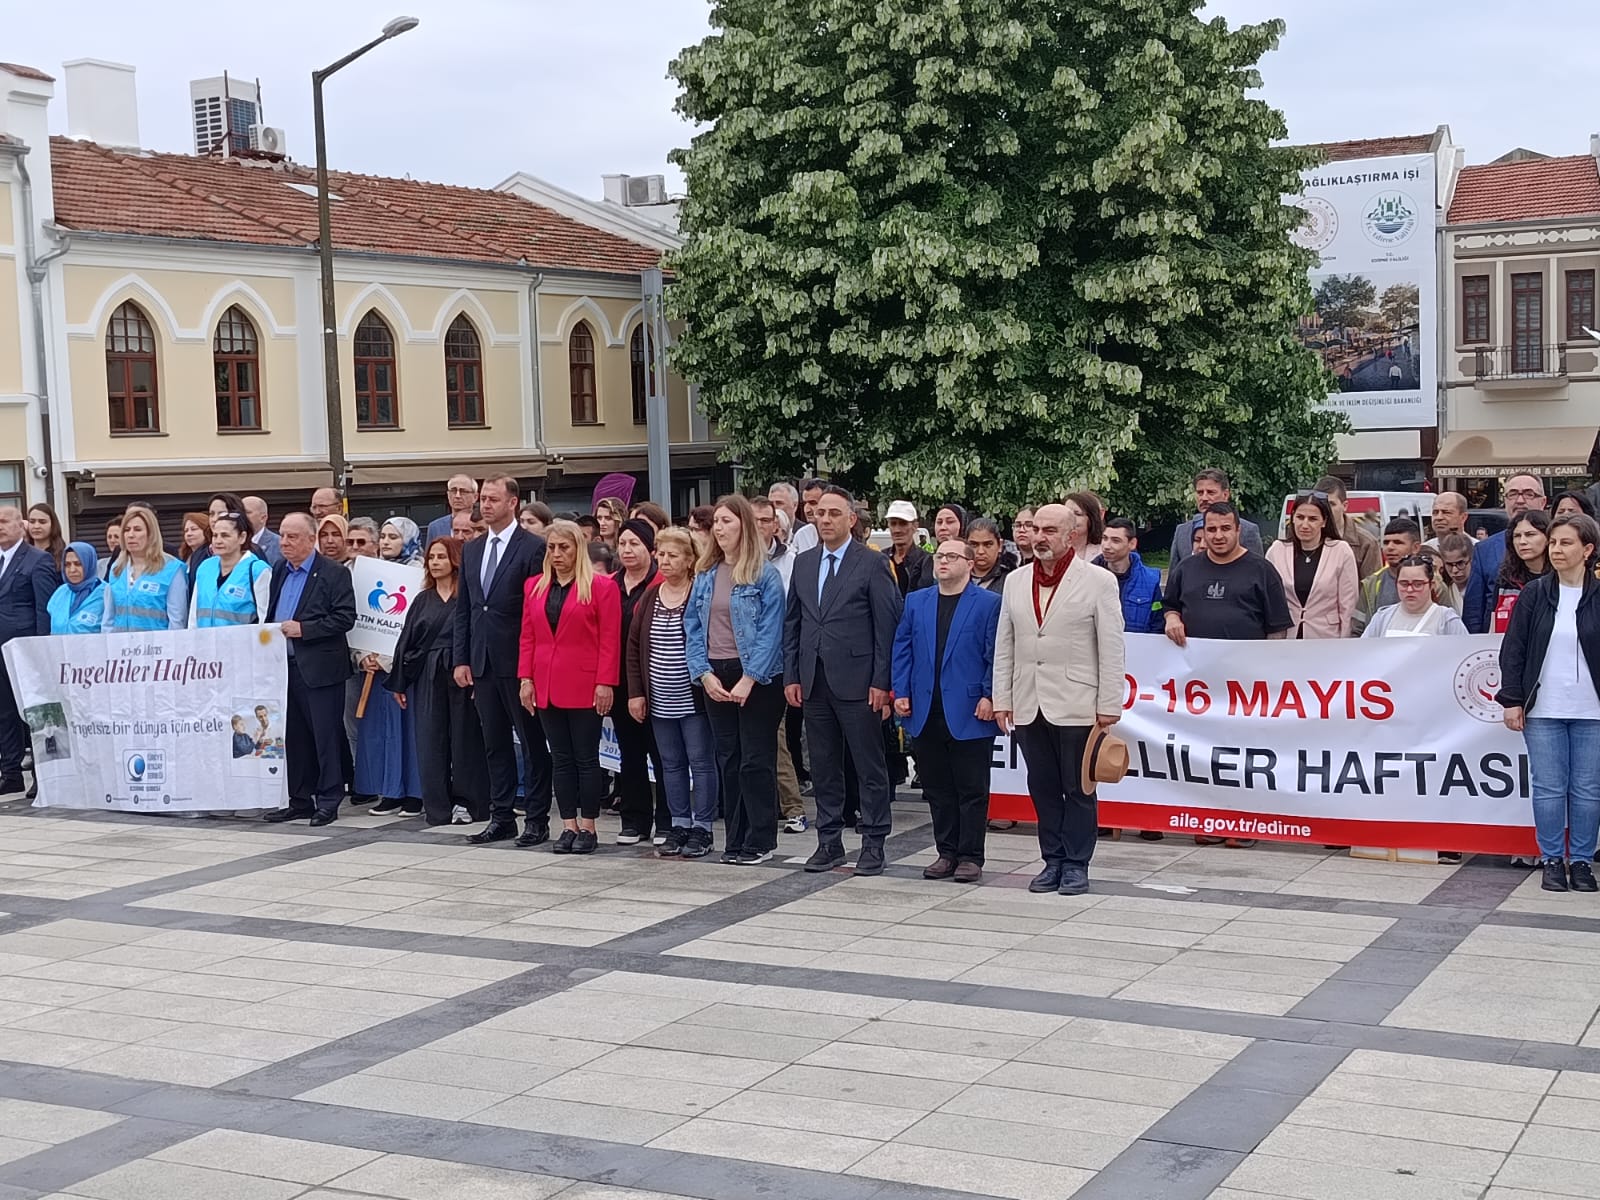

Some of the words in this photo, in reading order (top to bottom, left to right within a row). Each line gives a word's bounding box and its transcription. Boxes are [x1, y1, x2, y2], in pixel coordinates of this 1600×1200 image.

[1302, 171, 1399, 188] AĞLIKLAŞTIRMA
[1403, 167, 1420, 182] İŞİ
[1437, 468, 1464, 476] KEMAL
[1468, 467, 1496, 476] AYGÜN
[1555, 466, 1584, 477] ÇANTA
[59, 658, 151, 690] Engelliler
[152, 656, 223, 686] Haftası
[1226, 679, 1395, 720] MAYIS
[112, 720, 131, 737] bir
[133, 719, 168, 740] dünya
[171, 719, 191, 738] için
[193, 718, 204, 733] el
[206, 717, 224, 733] ele
[1297, 749, 1530, 799] HAFTASI
[1169, 812, 1312, 838] aile.gov.tr/edirne
